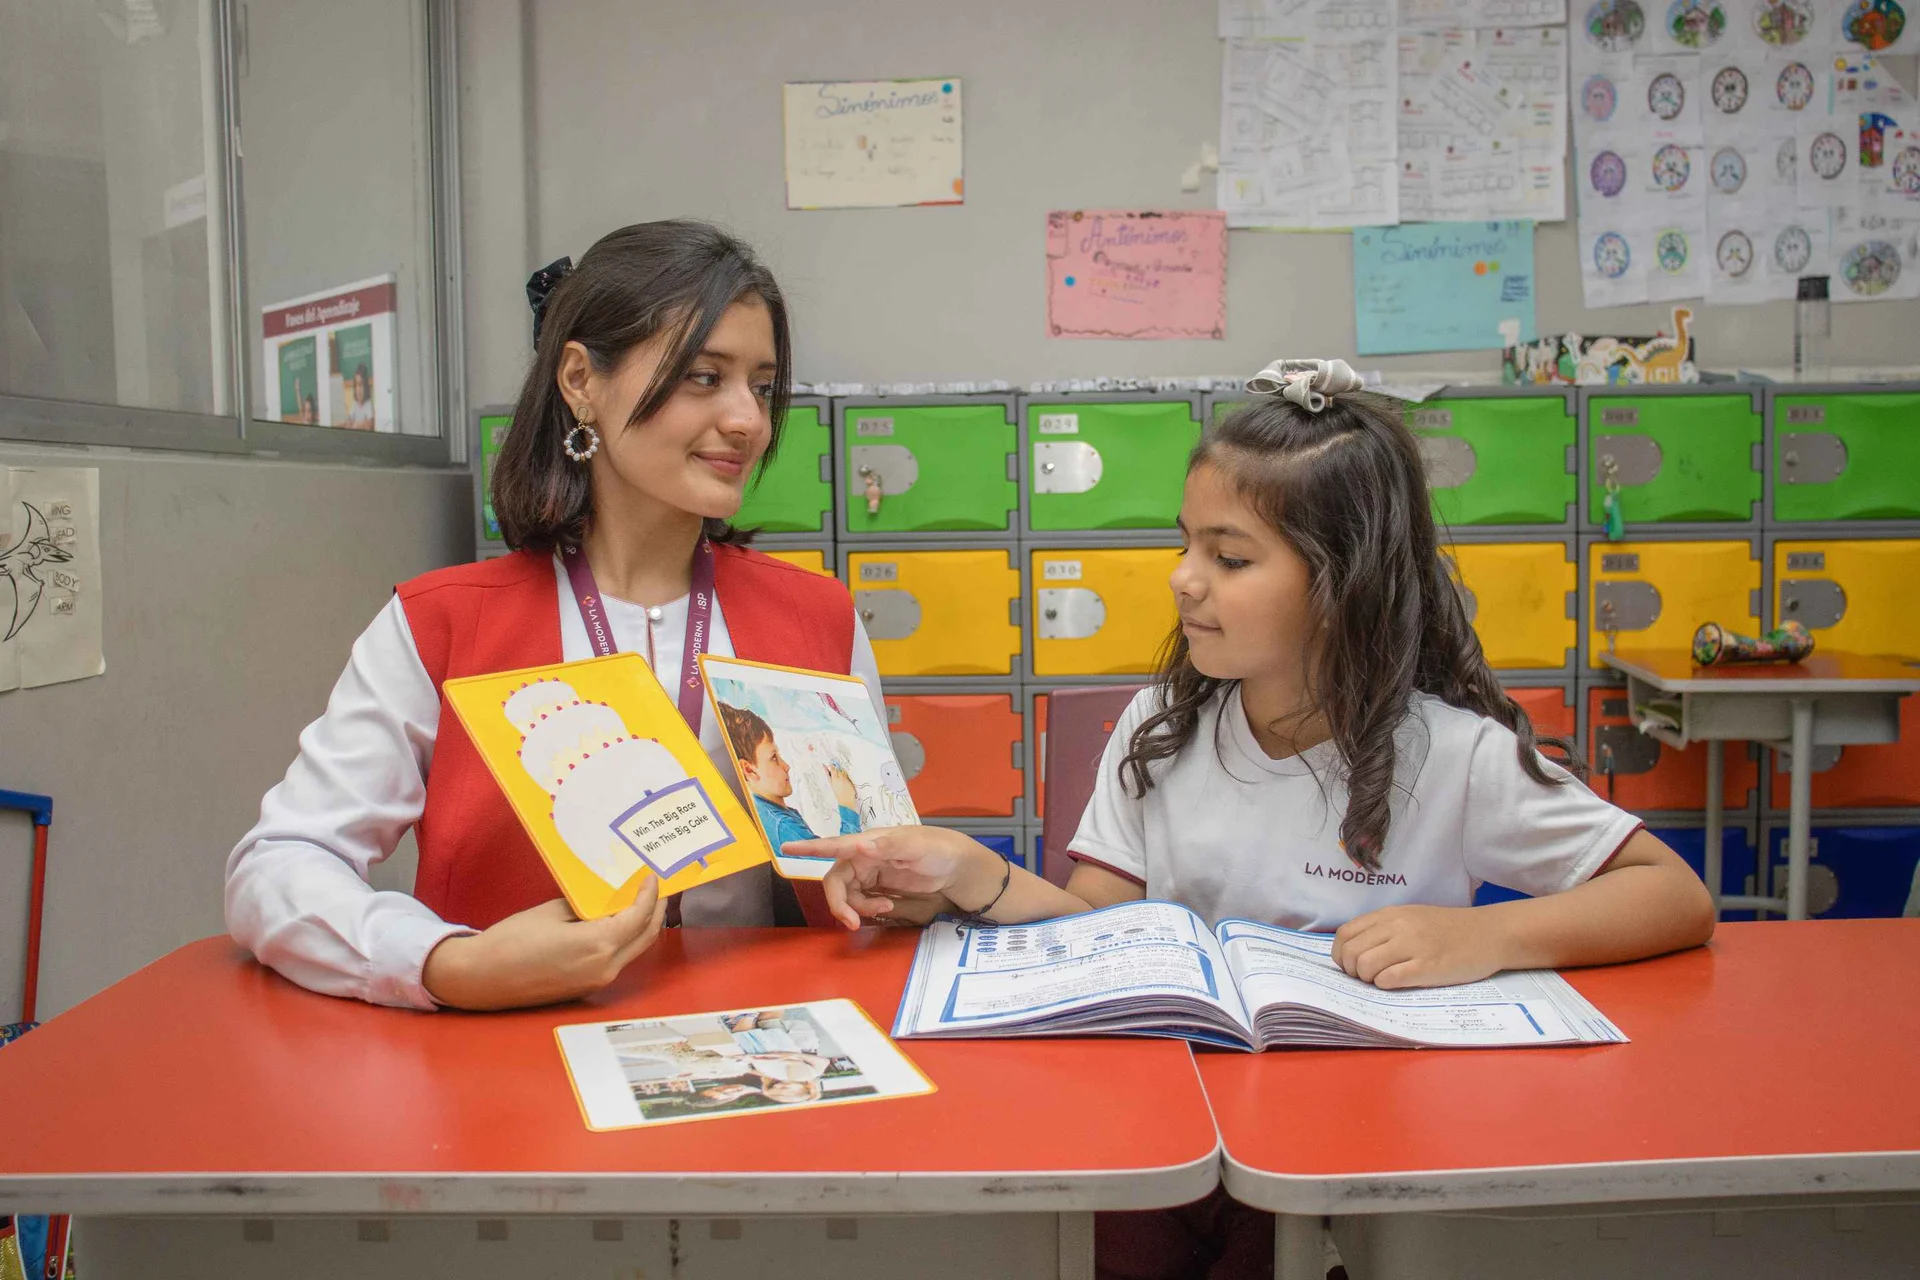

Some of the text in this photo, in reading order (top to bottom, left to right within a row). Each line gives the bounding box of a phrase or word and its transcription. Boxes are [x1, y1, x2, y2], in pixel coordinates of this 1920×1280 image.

[55, 571, 80, 588] BODY
[863, 565, 892, 578] 026
[588, 609, 599, 621] LA
[632, 800, 697, 838] Win The Big Race
[642, 813, 709, 853] Win This Big Cake
[1304, 862, 1407, 886] LA MODERNA
